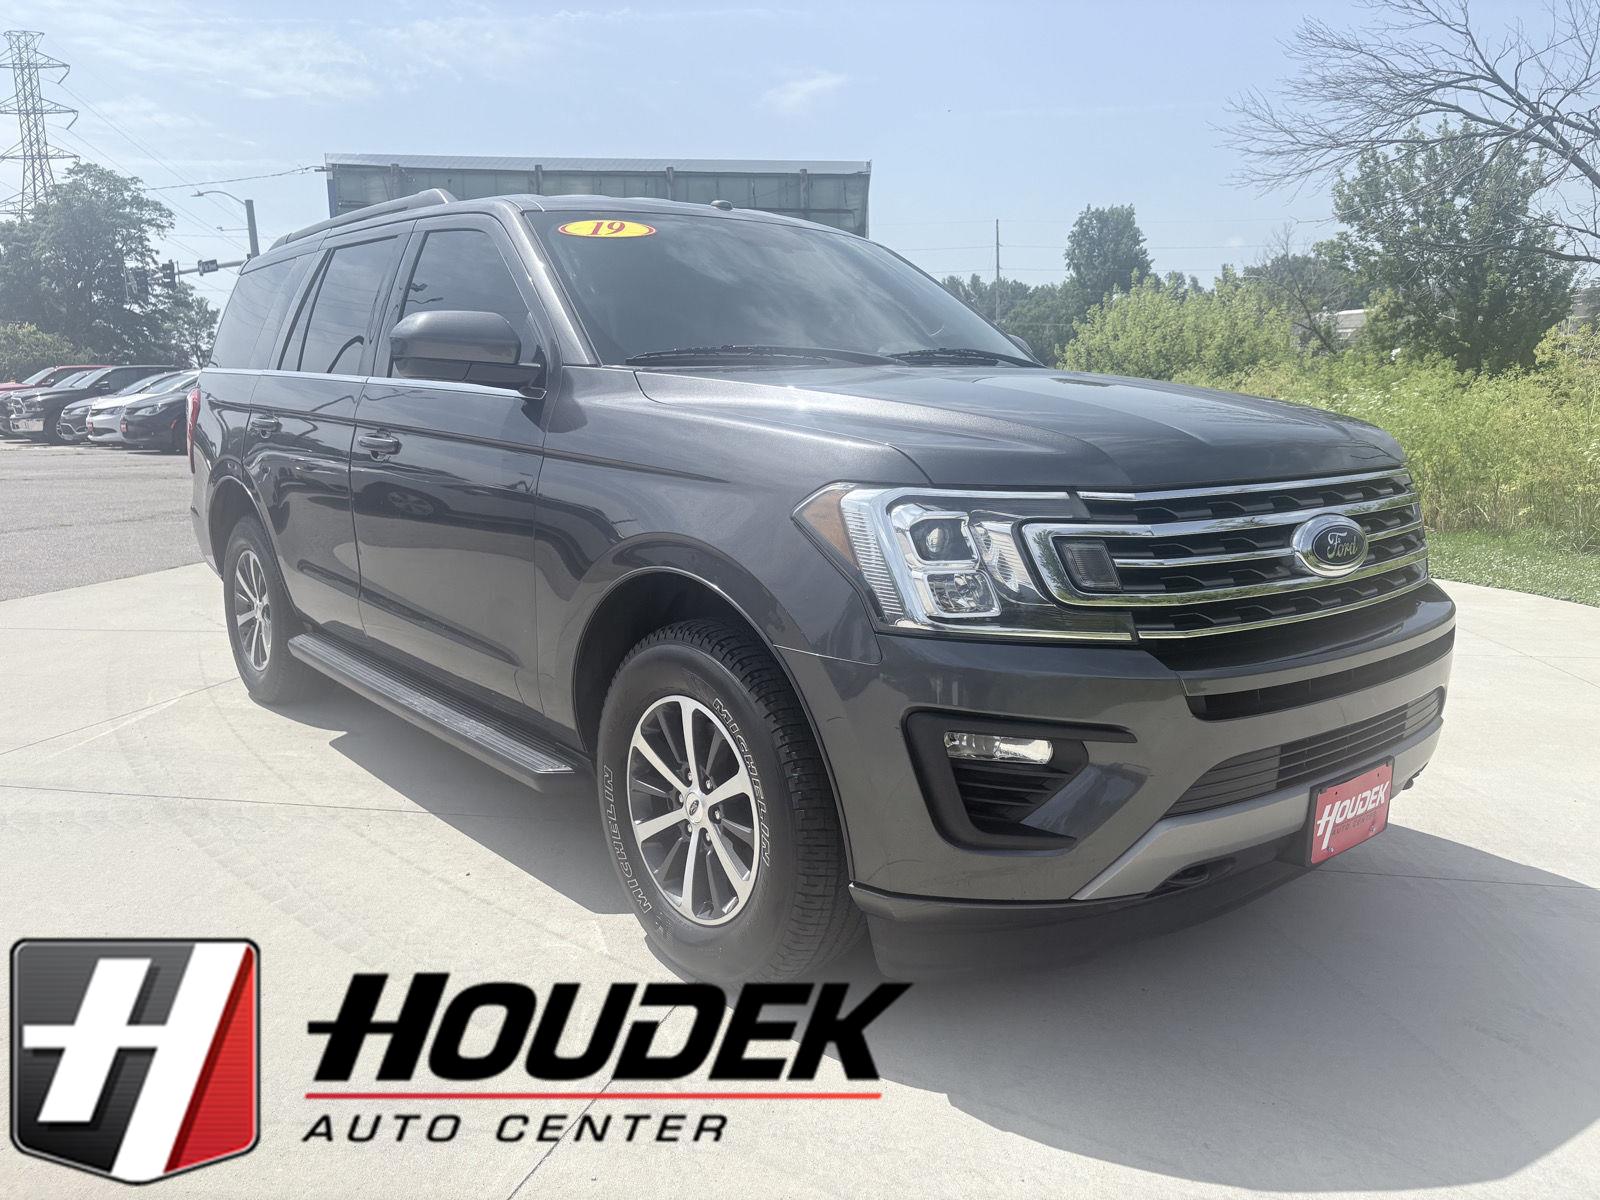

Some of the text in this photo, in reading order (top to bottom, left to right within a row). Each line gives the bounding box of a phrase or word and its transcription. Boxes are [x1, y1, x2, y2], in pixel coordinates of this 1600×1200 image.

[587, 221, 626, 236] 19
[1326, 531, 1358, 560] Ford
[712, 698, 771, 867] MICHELIN
[1317, 781, 1390, 851] HOUDEK
[603, 764, 652, 914] MICHELIN
